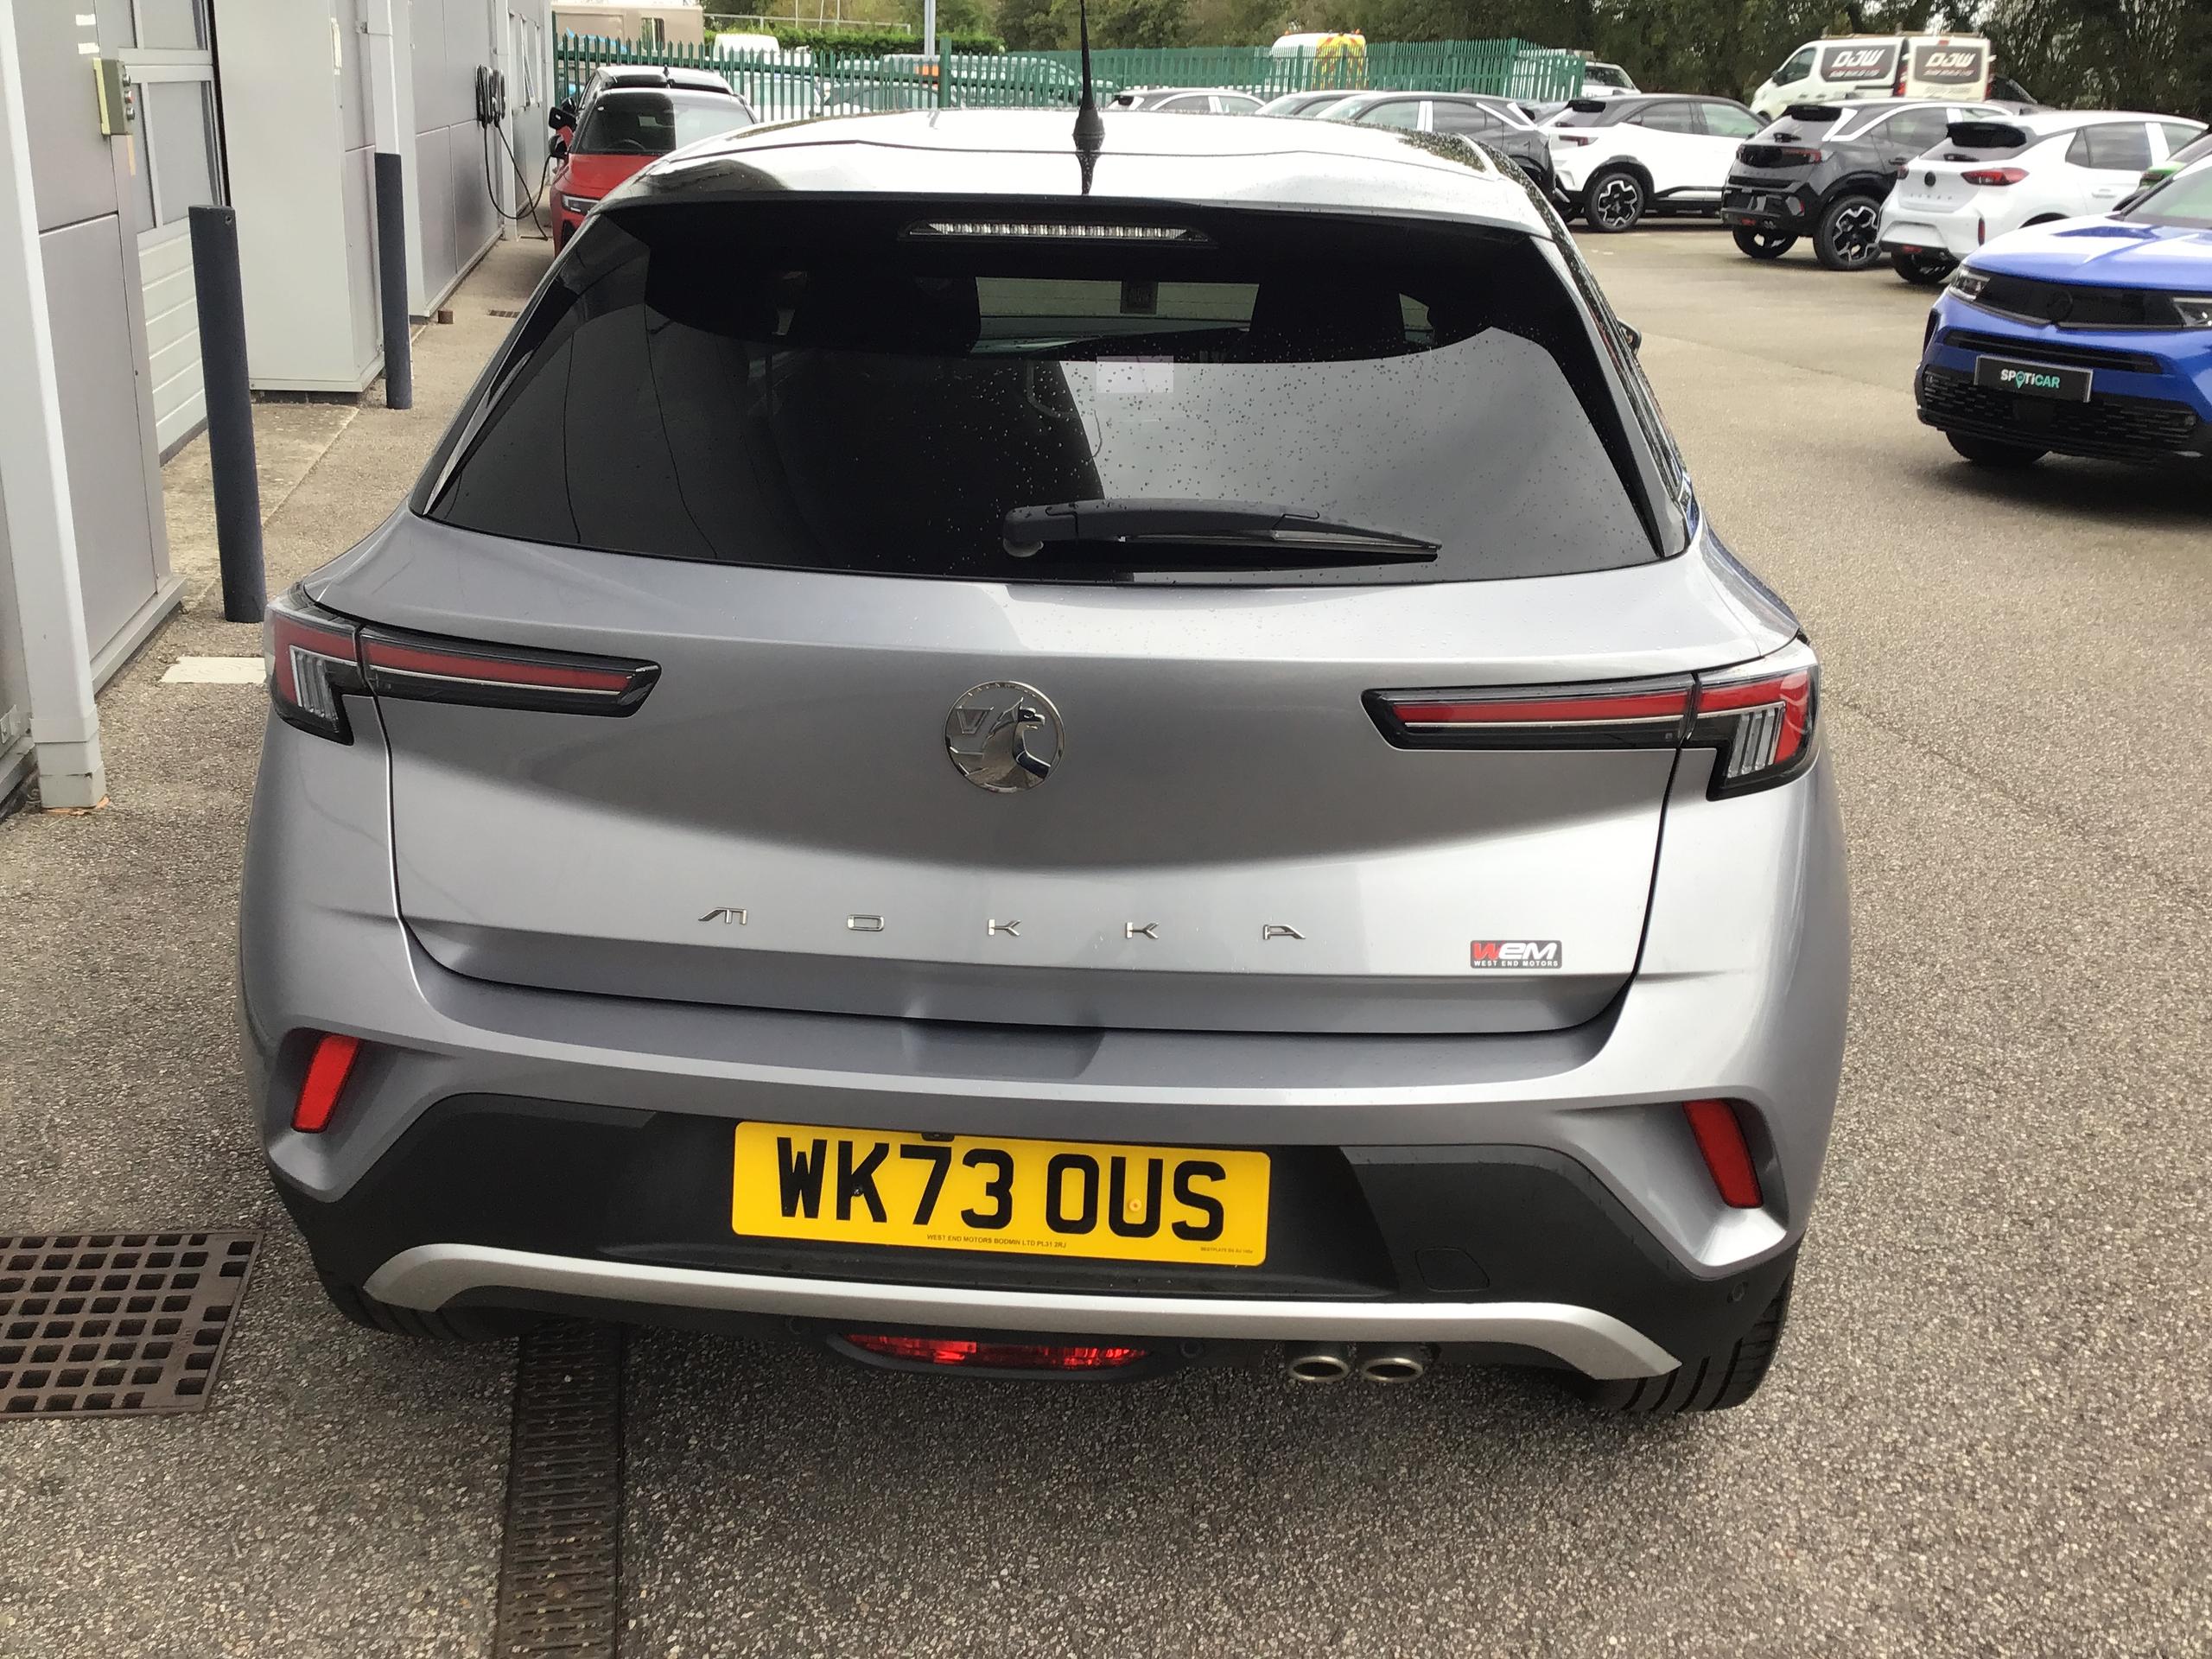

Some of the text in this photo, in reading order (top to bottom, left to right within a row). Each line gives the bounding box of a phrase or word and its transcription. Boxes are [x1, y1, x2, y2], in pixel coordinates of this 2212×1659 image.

[777, 1136, 1227, 1242] WK73 OUS
[963, 1236, 992, 1244] MOTORS
